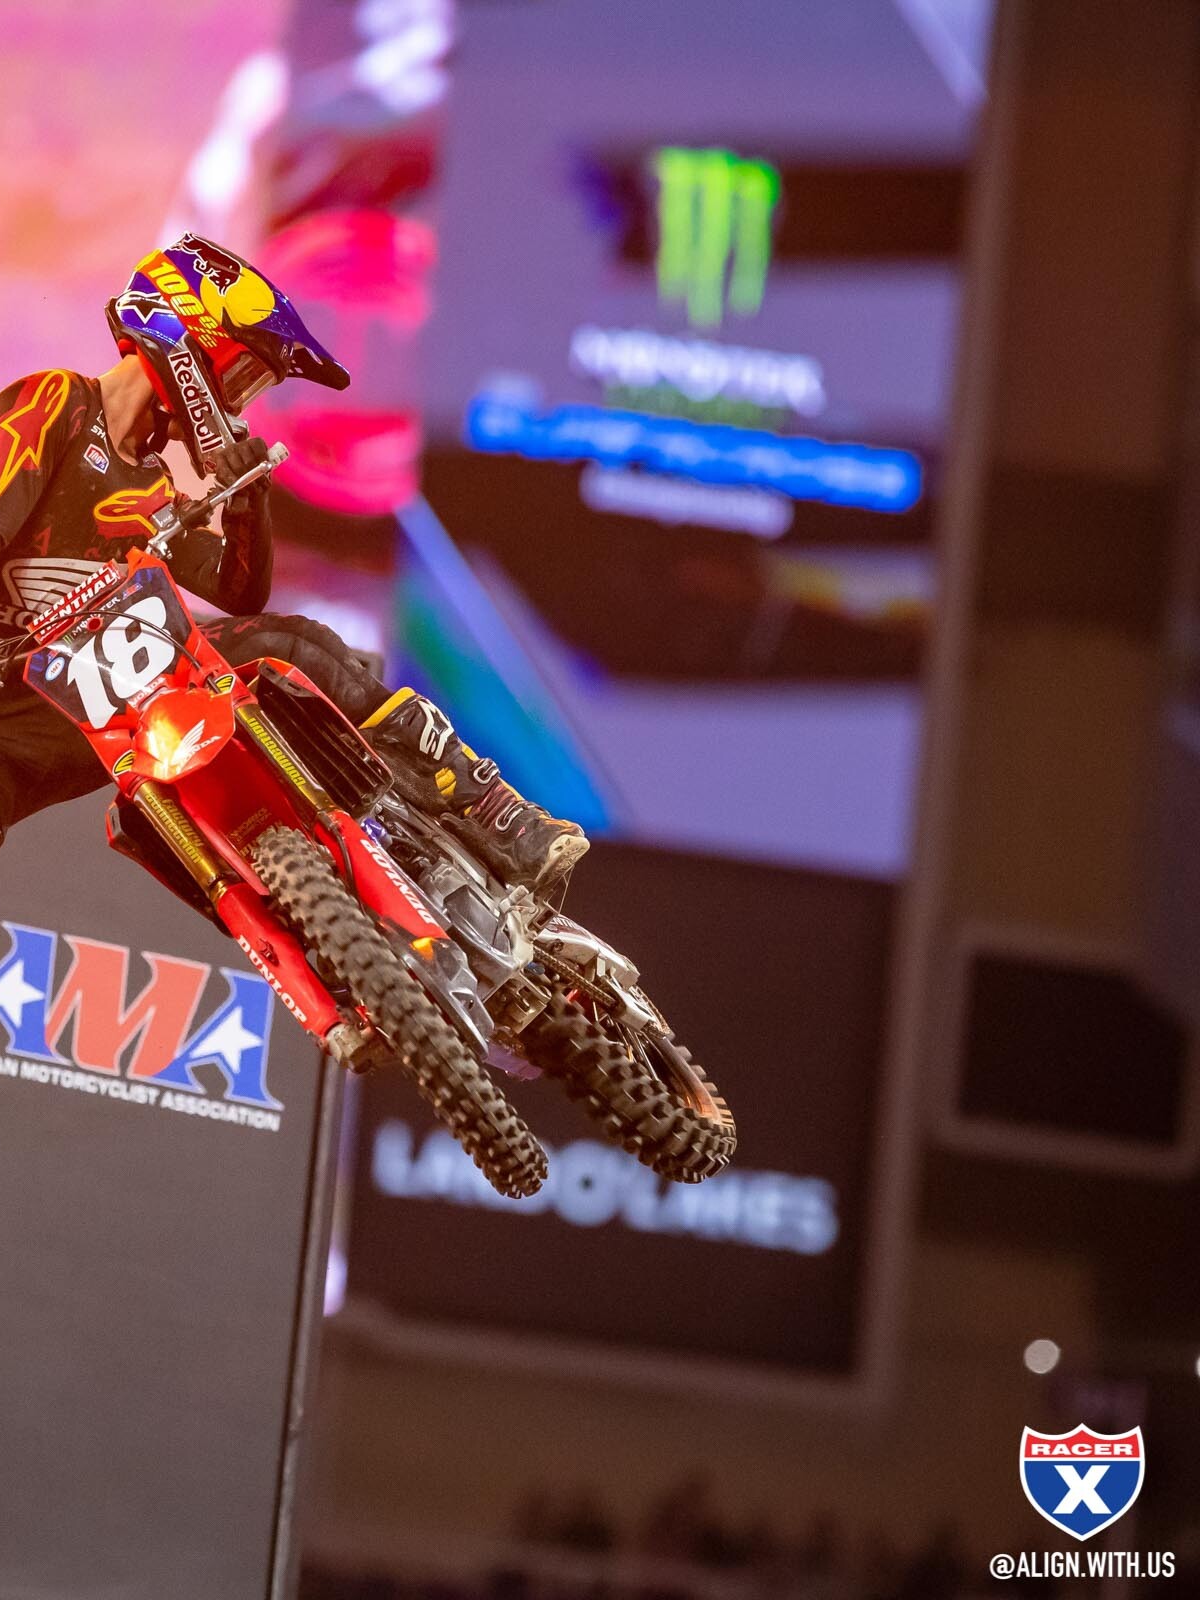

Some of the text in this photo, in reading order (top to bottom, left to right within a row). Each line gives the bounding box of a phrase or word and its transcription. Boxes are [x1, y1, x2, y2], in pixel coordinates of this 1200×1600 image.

[147, 261, 231, 349] 100%
[67, 596, 176, 730] 18
[360, 839, 441, 928] DUNLOP
[237, 934, 308, 1024] DUNLOP
[20, 1060, 160, 1106] MOTORCYCLIST
[160, 1090, 282, 1133] ASSOCIATION
